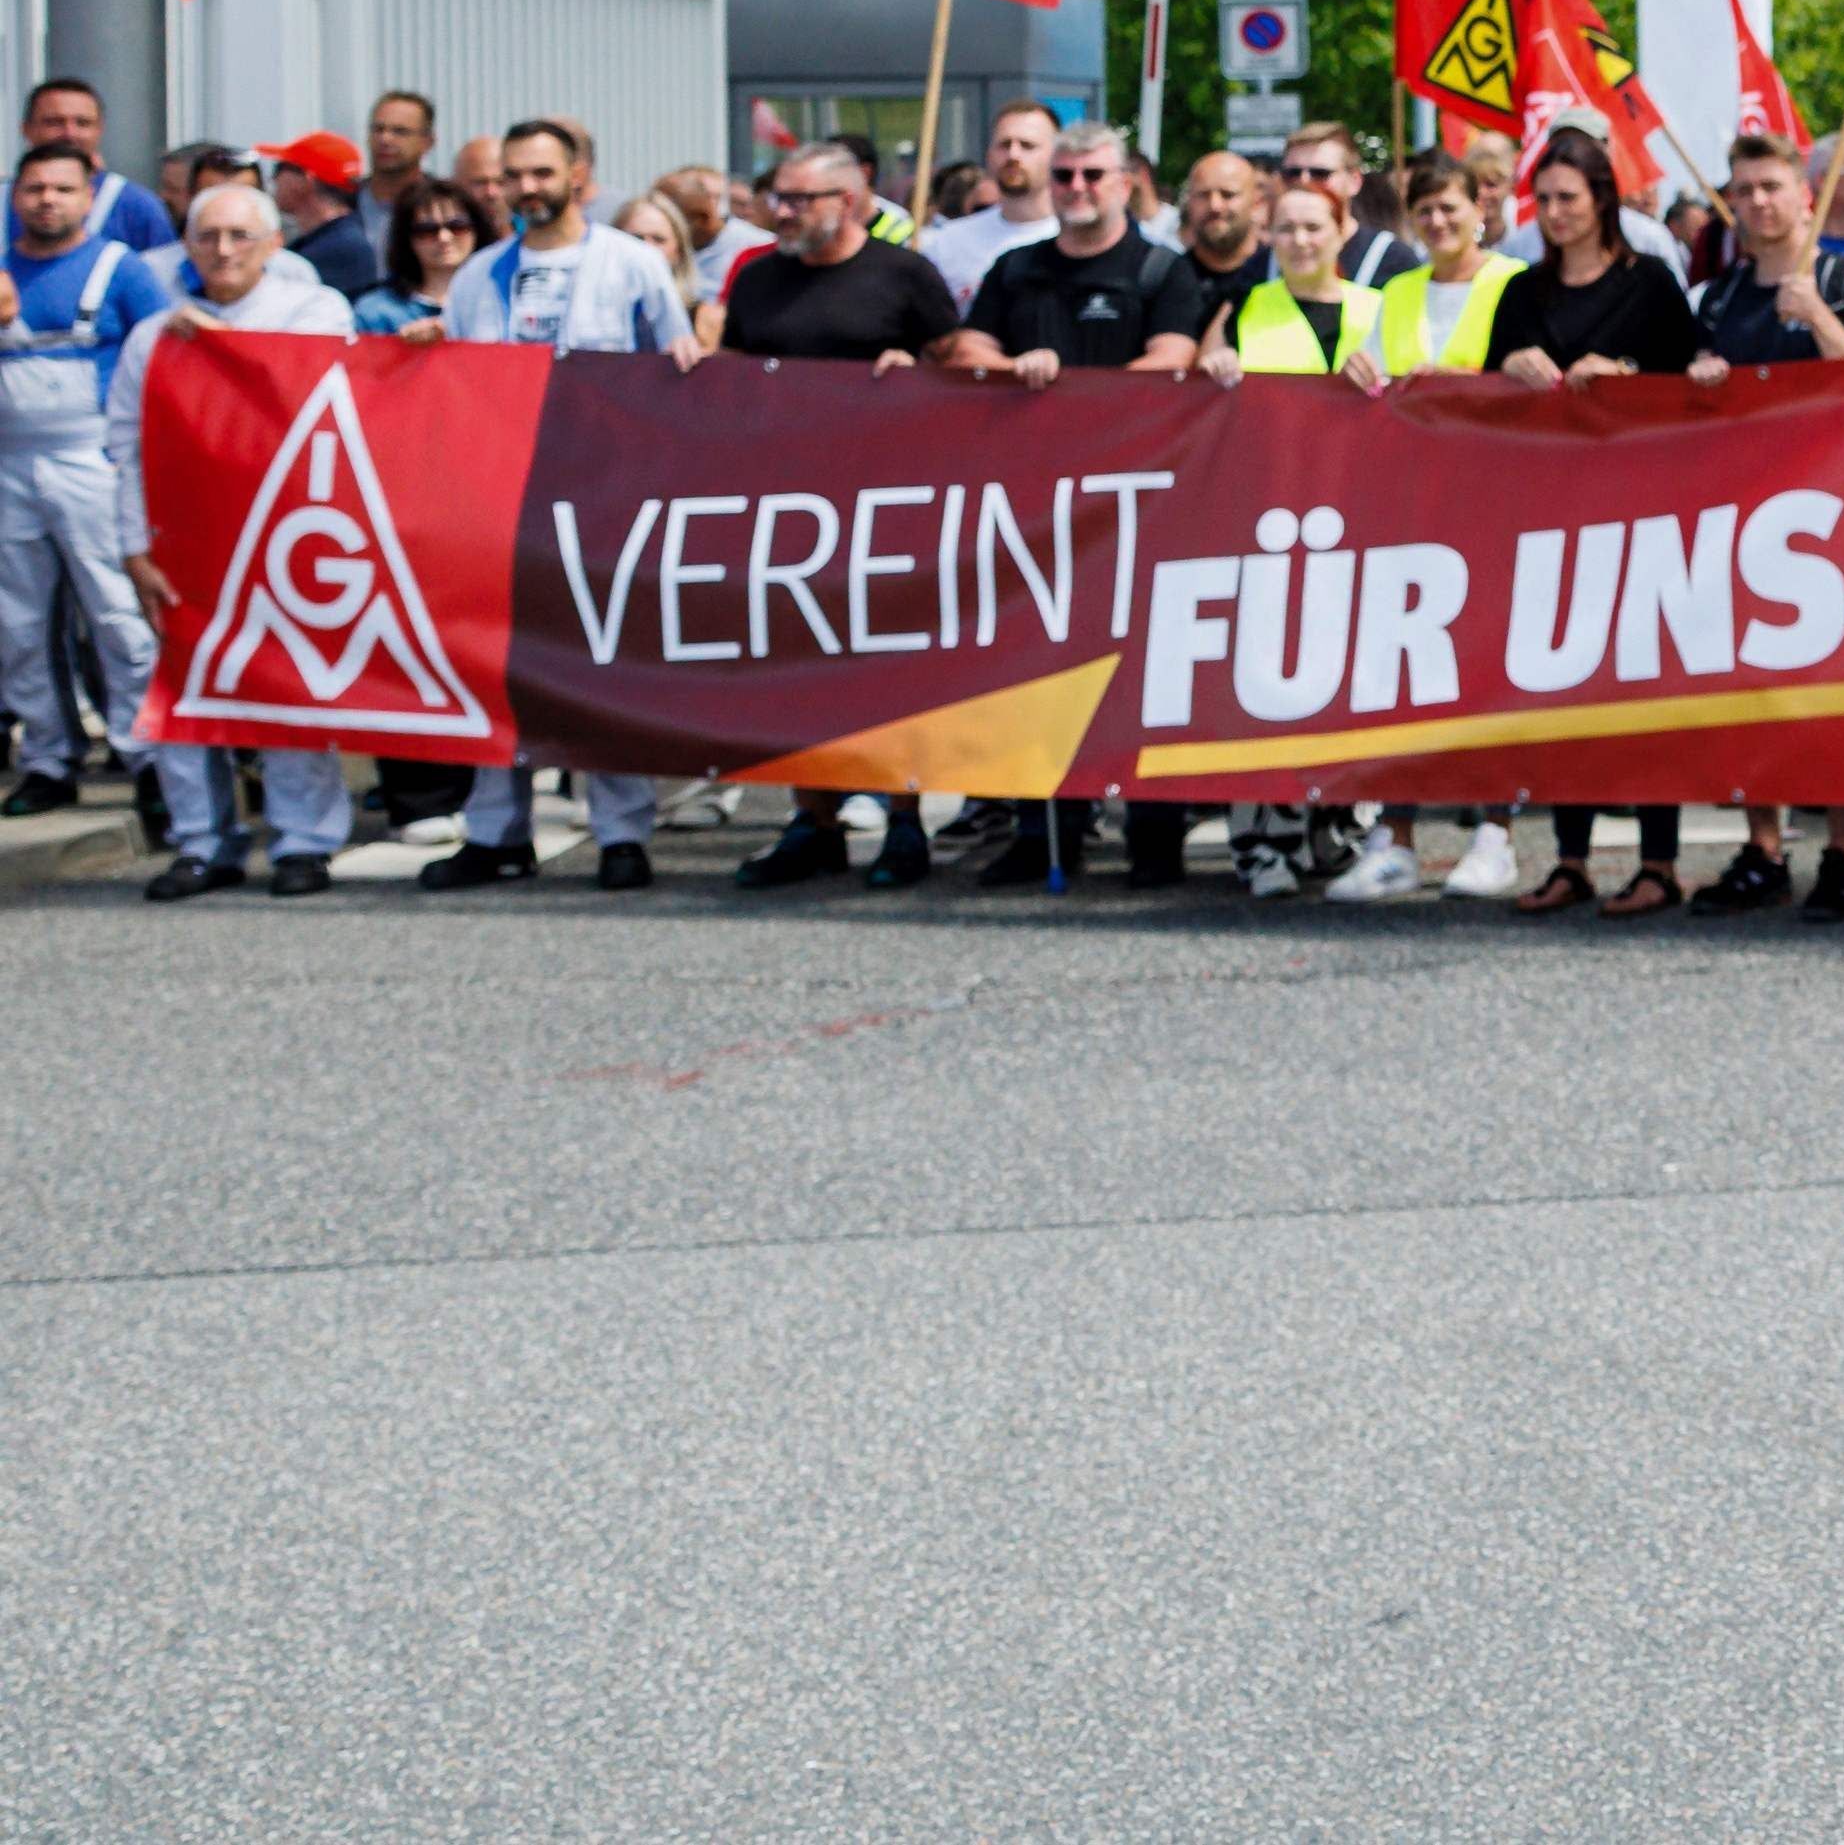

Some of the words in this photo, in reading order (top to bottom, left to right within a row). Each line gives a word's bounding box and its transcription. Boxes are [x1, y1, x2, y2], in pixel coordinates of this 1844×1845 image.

[214, 428, 449, 708] IGM
[553, 469, 1176, 665] VEREINT
[1141, 505, 1470, 729] FÜR
